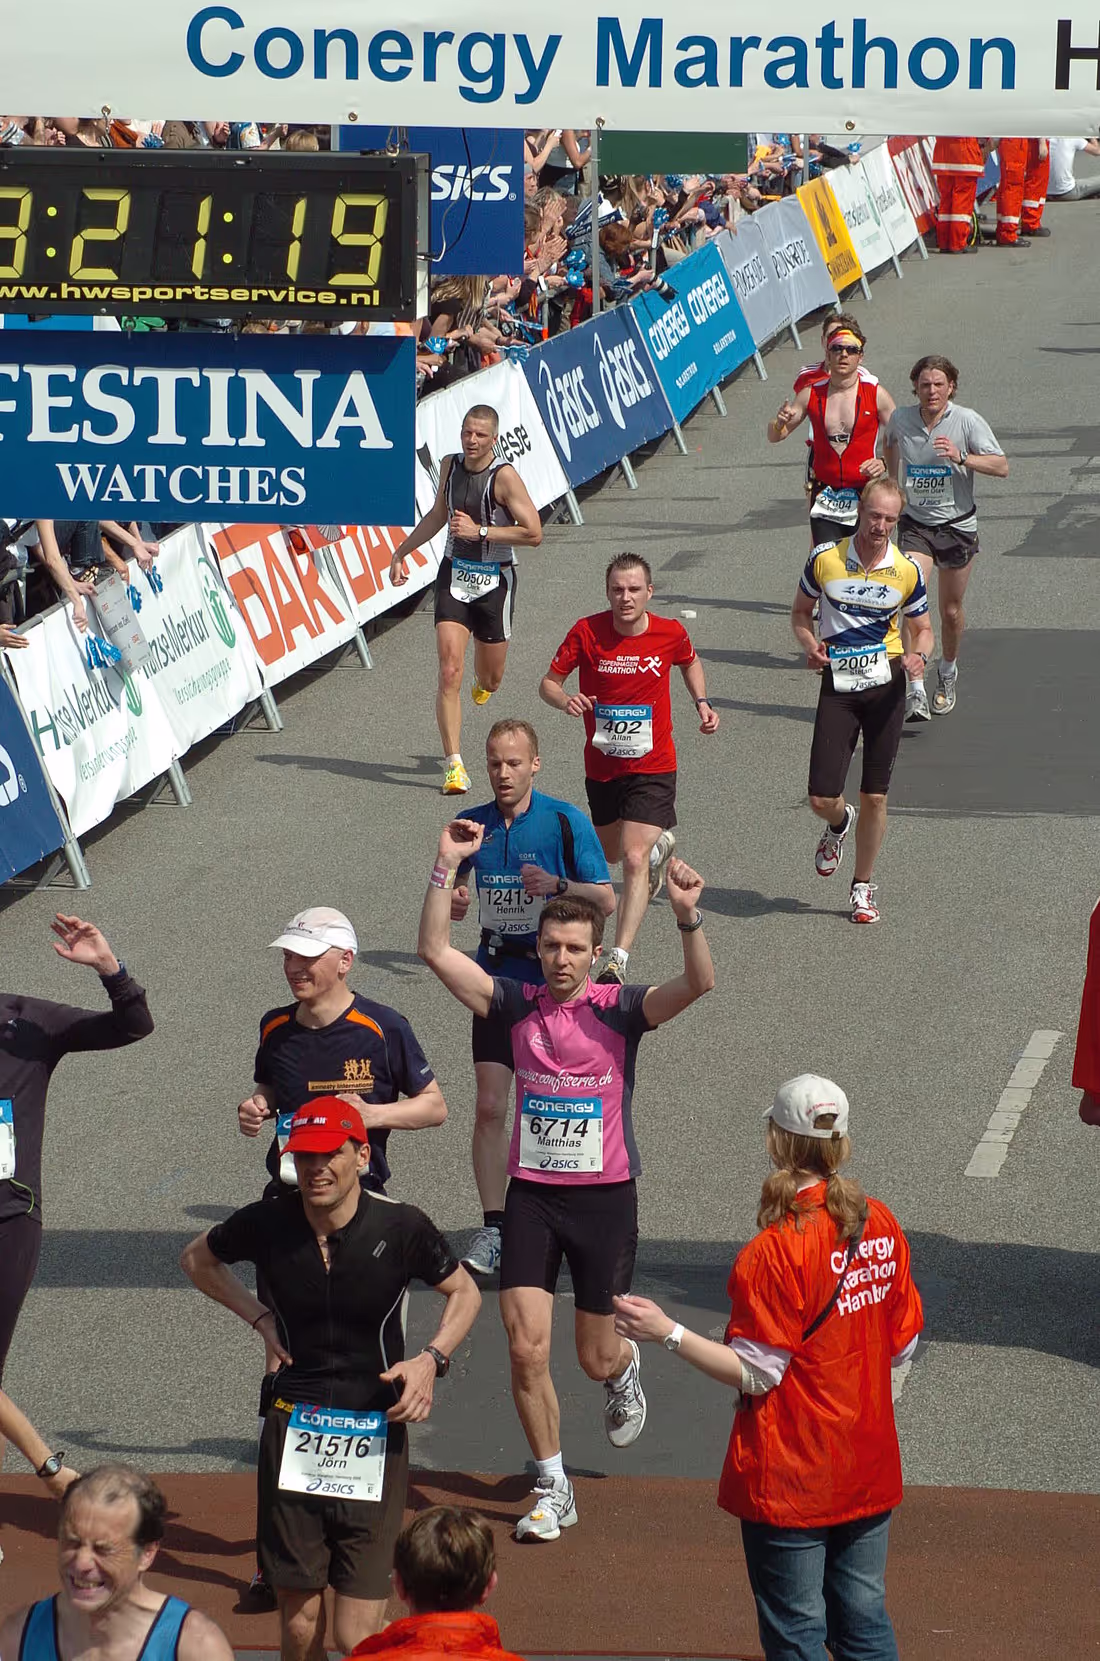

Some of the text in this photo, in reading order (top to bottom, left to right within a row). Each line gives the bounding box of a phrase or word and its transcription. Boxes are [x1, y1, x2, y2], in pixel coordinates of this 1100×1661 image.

[186, 6, 562, 104] Conergy
[595, 17, 1016, 90] Marathon
[56, 463, 307, 507] WATCHES
[912, 477, 945, 489] 15504
[457, 570, 492, 586] 20508
[838, 652, 879, 671] 2004
[597, 665, 637, 675] MARATHON
[598, 708, 647, 717] CONERGY
[602, 720, 643, 735] 402
[496, 905, 525, 914] Henrik
[528, 1099, 594, 1113] CONERGY
[529, 1116, 589, 1138] 6714
[537, 1136, 582, 1148] Matthias
[300, 1411, 378, 1430] CONERGY
[295, 1432, 371, 1458] 21516
[317, 1457, 347, 1469] Jörn
